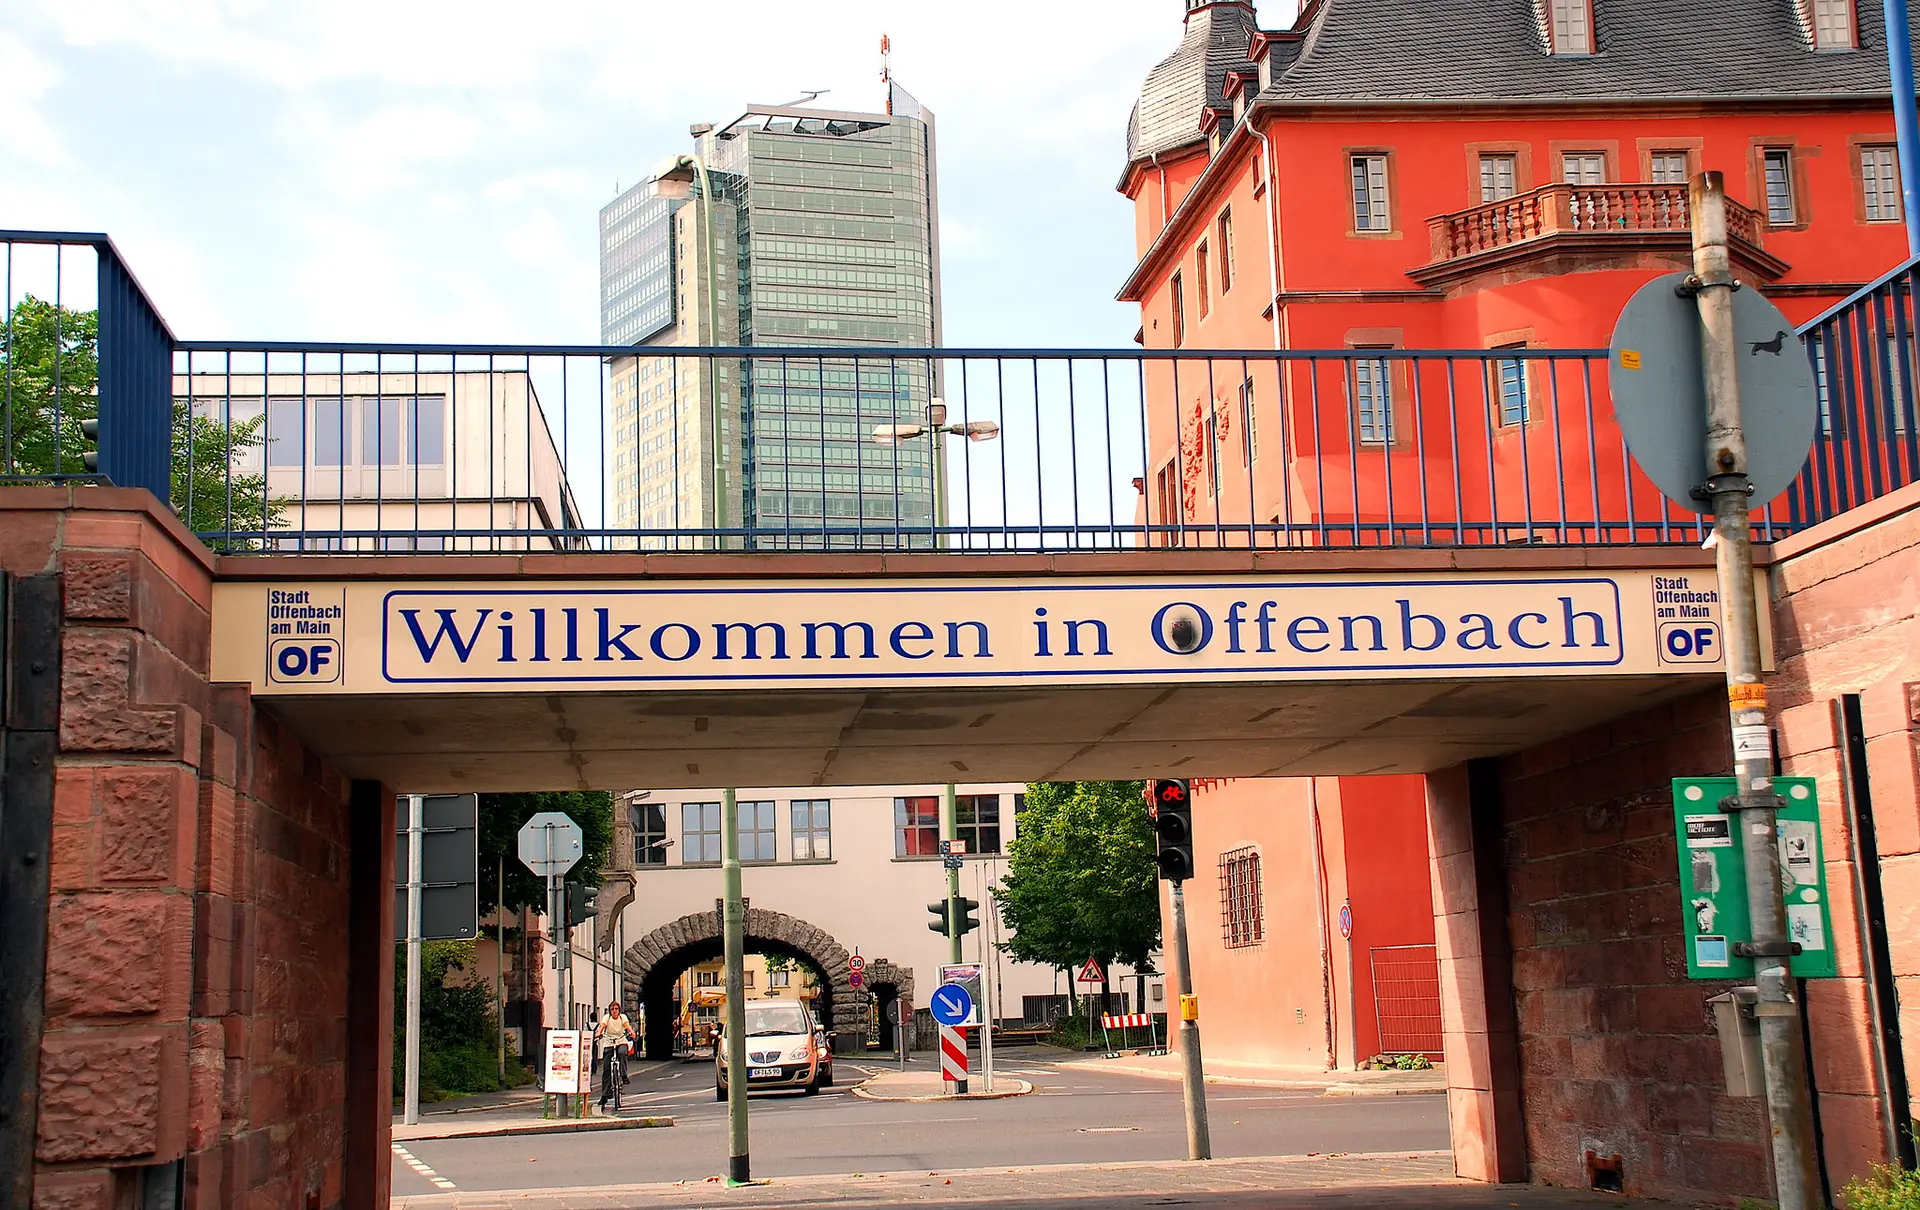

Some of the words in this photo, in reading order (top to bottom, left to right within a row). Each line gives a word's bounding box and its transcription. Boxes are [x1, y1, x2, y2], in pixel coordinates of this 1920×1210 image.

[1655, 577, 1688, 589] Stadt
[271, 590, 310, 604] Stadt
[1656, 590, 1718, 603] Offenbach
[271, 605, 342, 619] Offenbach
[1657, 608, 1675, 618] am
[1679, 605, 1710, 618] Main
[271, 622, 292, 634] am
[296, 620, 331, 634] Main
[398, 607, 994, 664] Willkommen
[1034, 607, 1113, 657] in
[1150, 597, 1610, 656] Offenbach
[1667, 628, 1713, 657] OF
[278, 645, 332, 676] OF
[853, 959, 861, 968] 30
